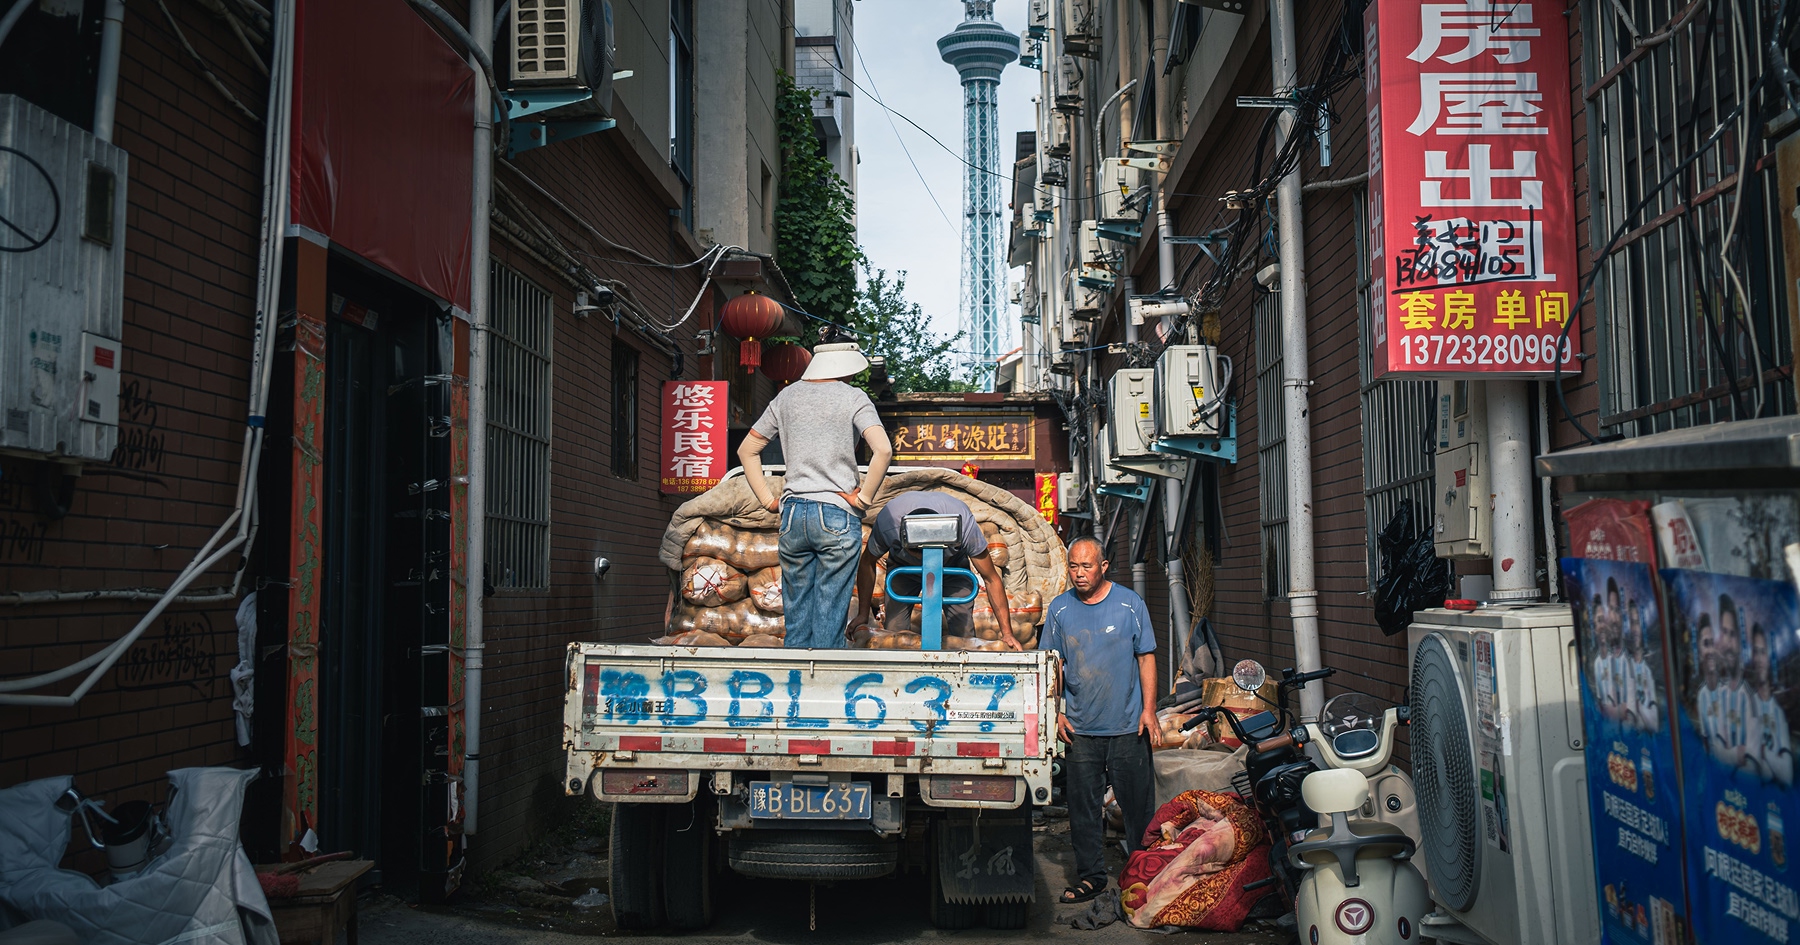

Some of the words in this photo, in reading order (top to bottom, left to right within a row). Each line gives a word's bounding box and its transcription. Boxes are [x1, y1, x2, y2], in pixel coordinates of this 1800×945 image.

[1406, 3, 1556, 282] 房屋出租
[1399, 290, 1476, 330] 套房
[1493, 290, 1570, 330] 单间
[1400, 334, 1572, 365] 13723280969
[670, 384, 715, 477] 悠乐民宿
[1703, 845, 1799, 922] 阿根廷国家足球队
[1725, 891, 1790, 945] 官方合作伙伴
